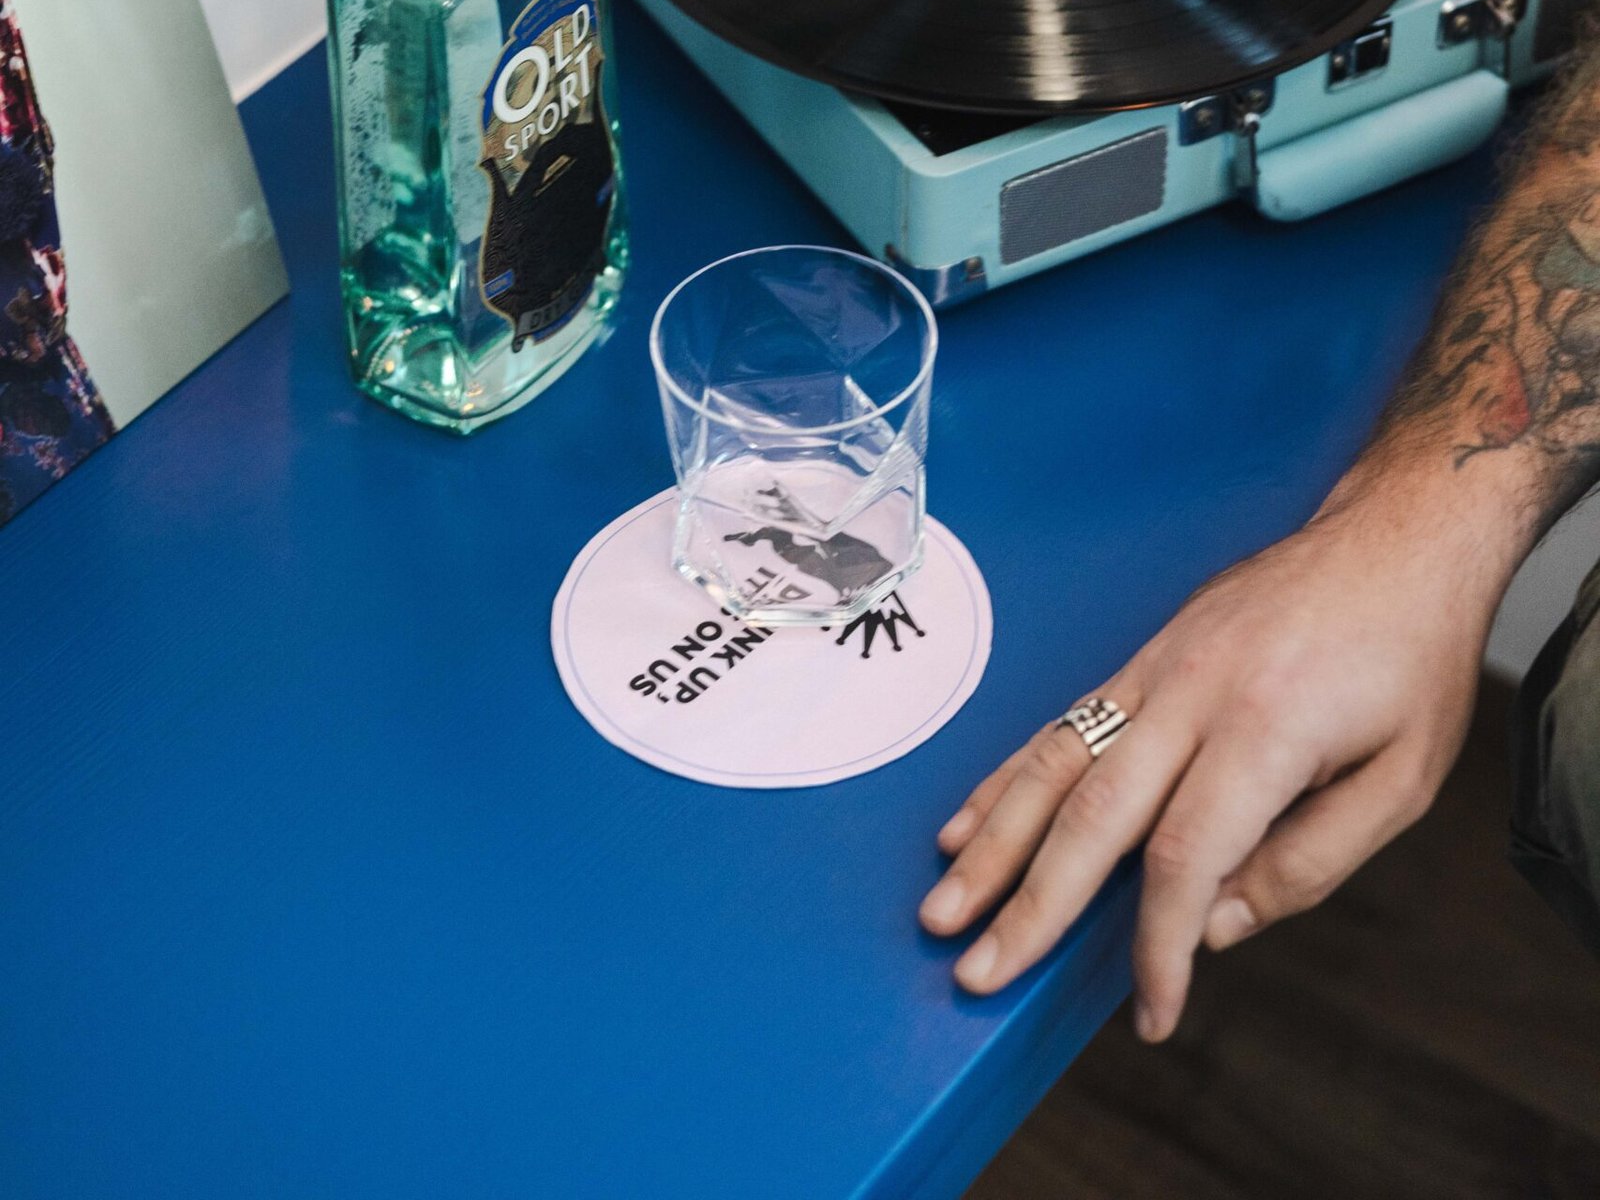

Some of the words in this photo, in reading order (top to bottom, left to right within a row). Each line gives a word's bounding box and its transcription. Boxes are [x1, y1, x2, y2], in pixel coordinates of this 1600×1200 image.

[492, 3, 591, 124] OLD
[504, 42, 593, 162] SPORT
[671, 620, 723, 661] ON
[709, 583, 813, 670] DINK
[628, 658, 681, 697] US
[656, 666, 720, 704] UP,
